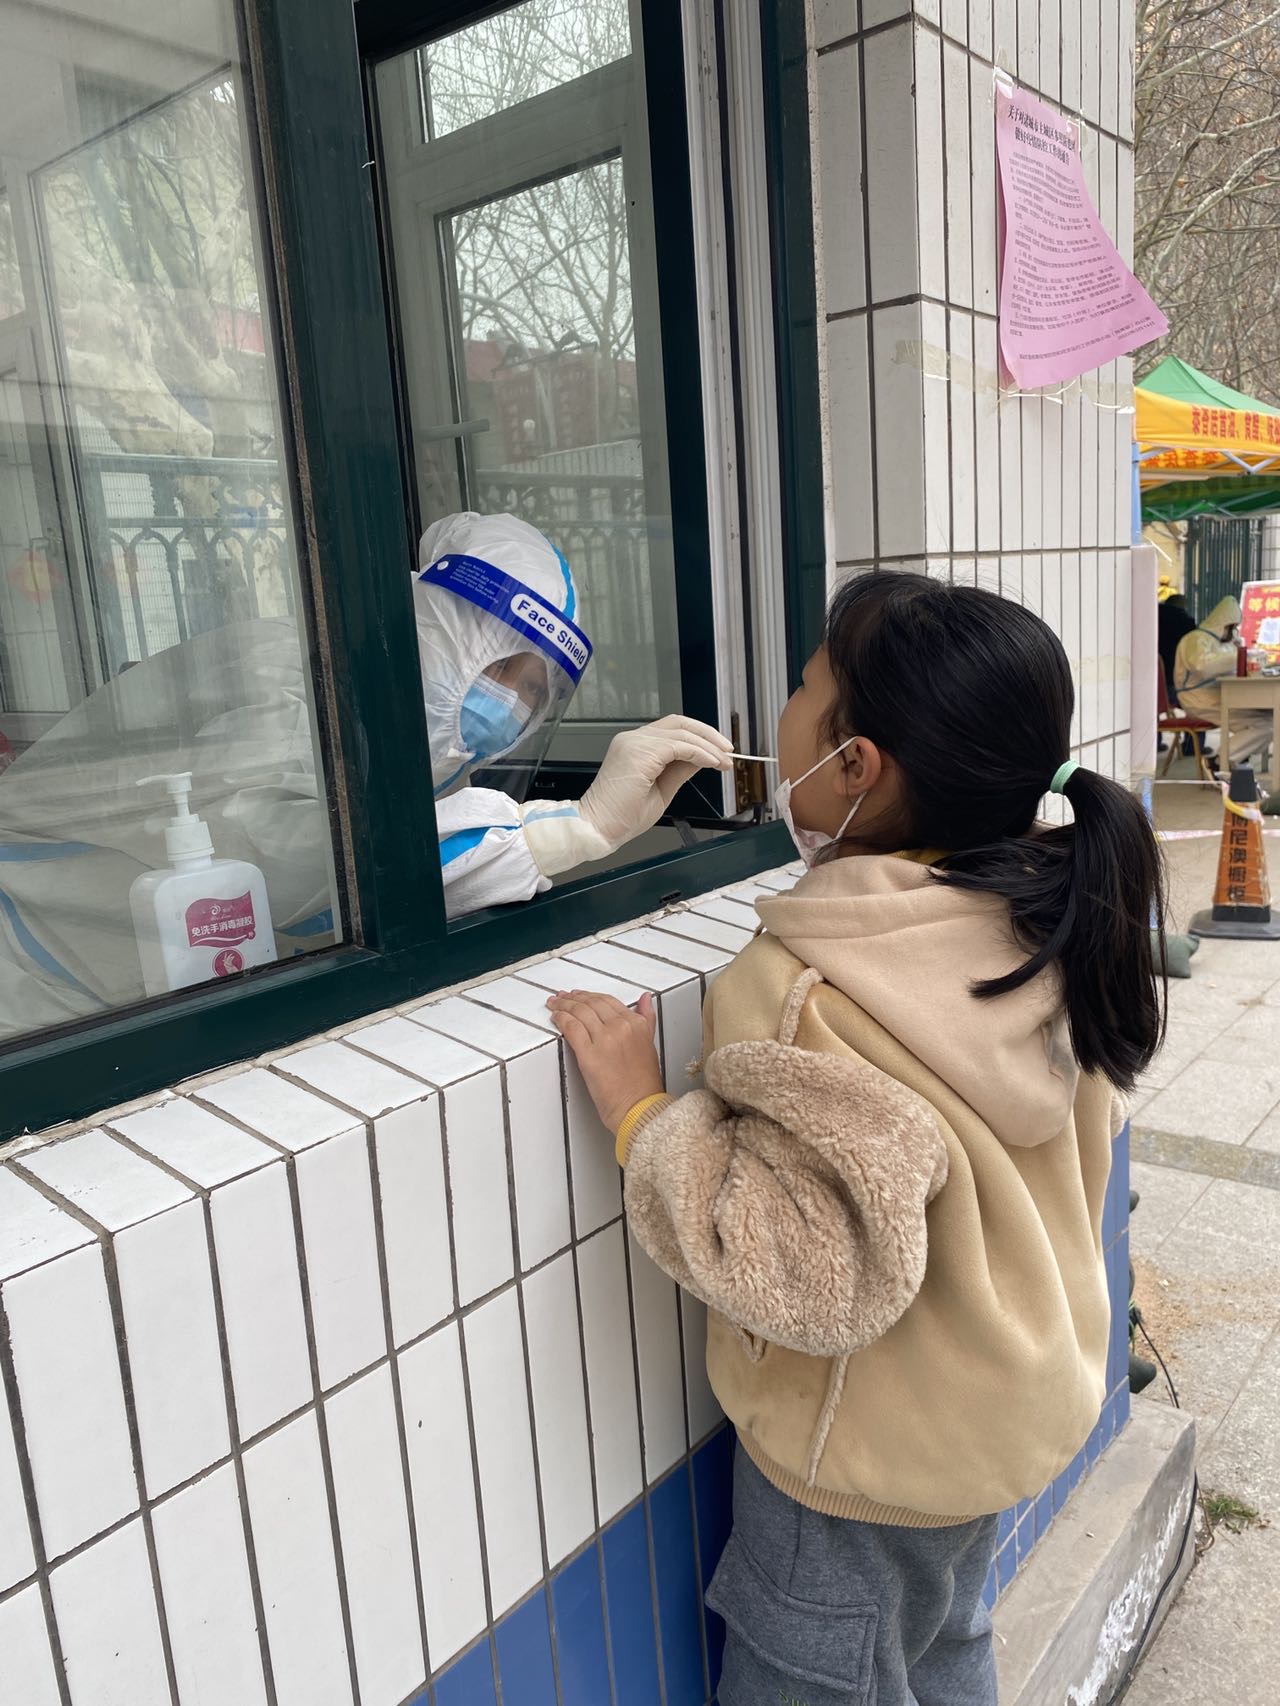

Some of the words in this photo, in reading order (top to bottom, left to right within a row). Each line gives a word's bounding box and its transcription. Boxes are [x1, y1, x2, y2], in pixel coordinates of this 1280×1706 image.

[517, 599, 555, 634] Face
[557, 630, 587, 665] Shield
[191, 915, 254, 937] 免洗手消毒凝胶
